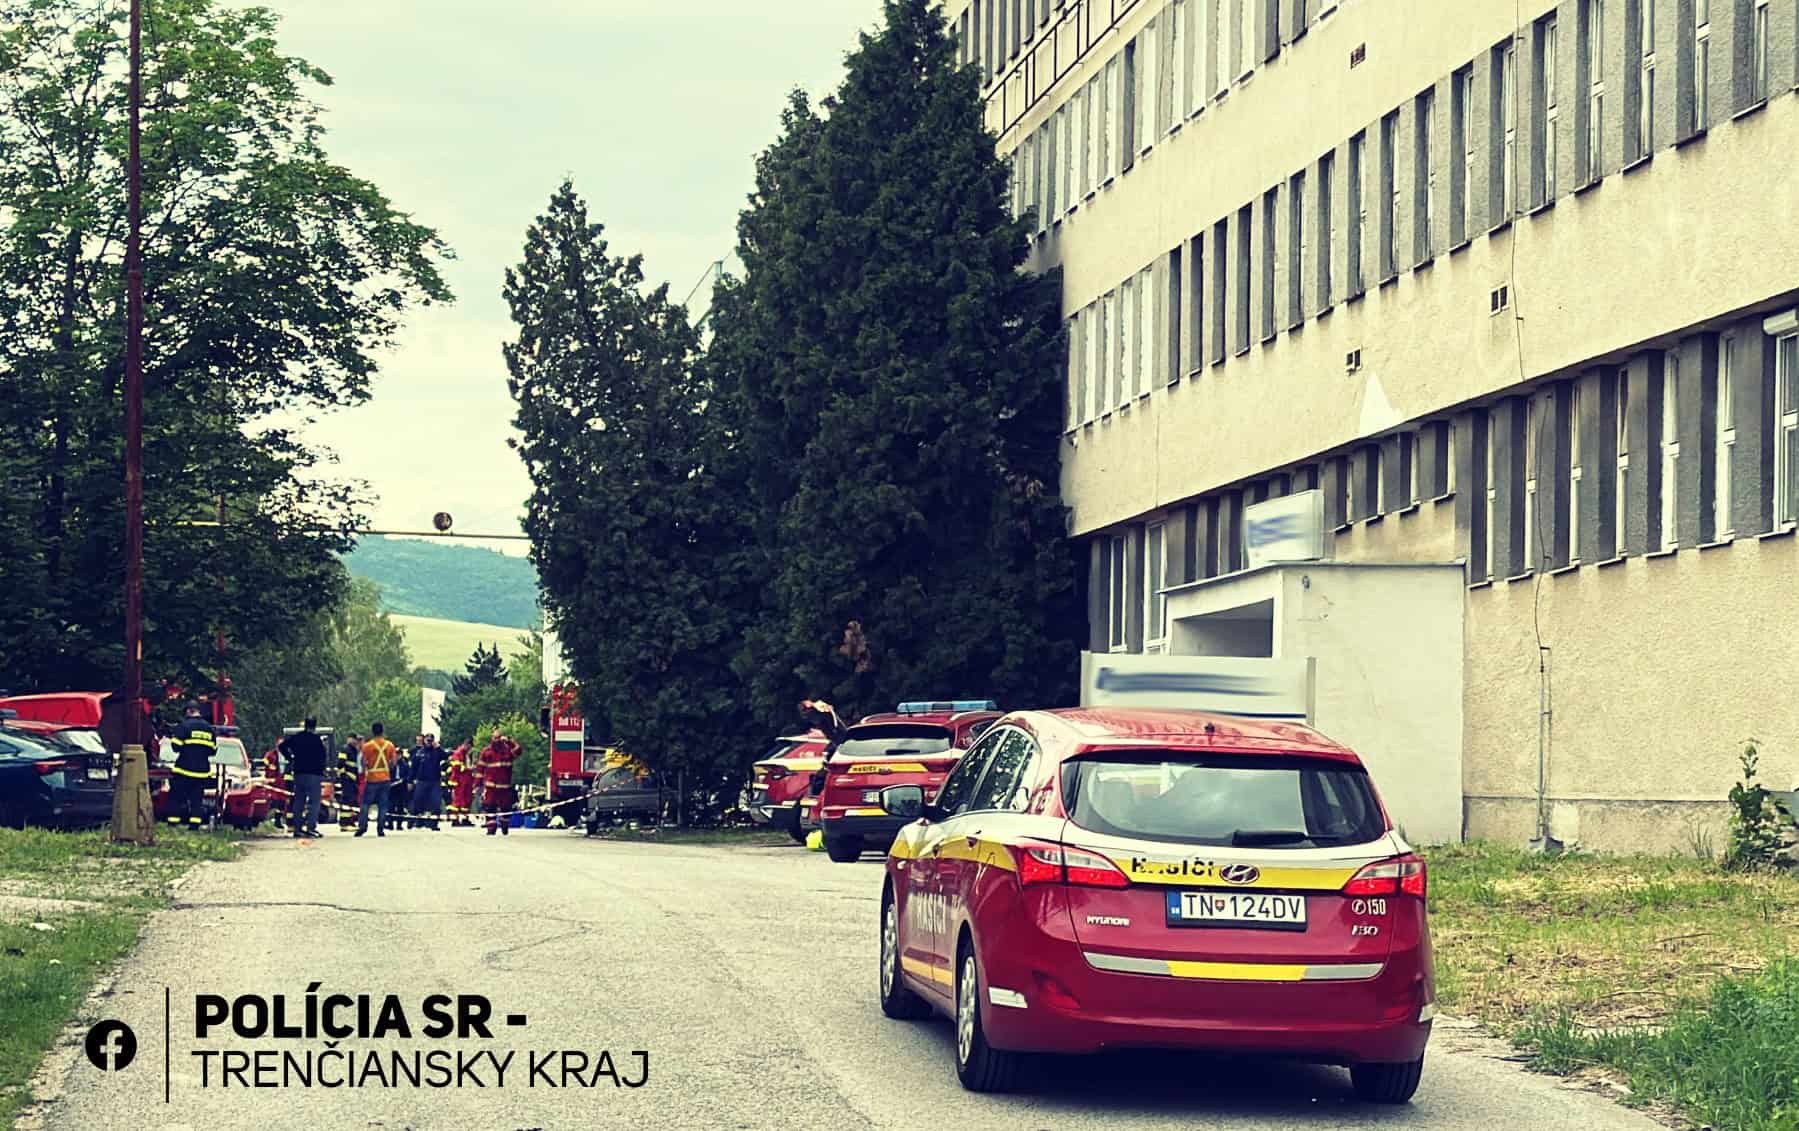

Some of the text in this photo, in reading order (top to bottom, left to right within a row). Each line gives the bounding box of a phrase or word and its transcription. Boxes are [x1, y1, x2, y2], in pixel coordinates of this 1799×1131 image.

[1184, 894, 1301, 919] TN 124DV
[1367, 898, 1387, 916] 150
